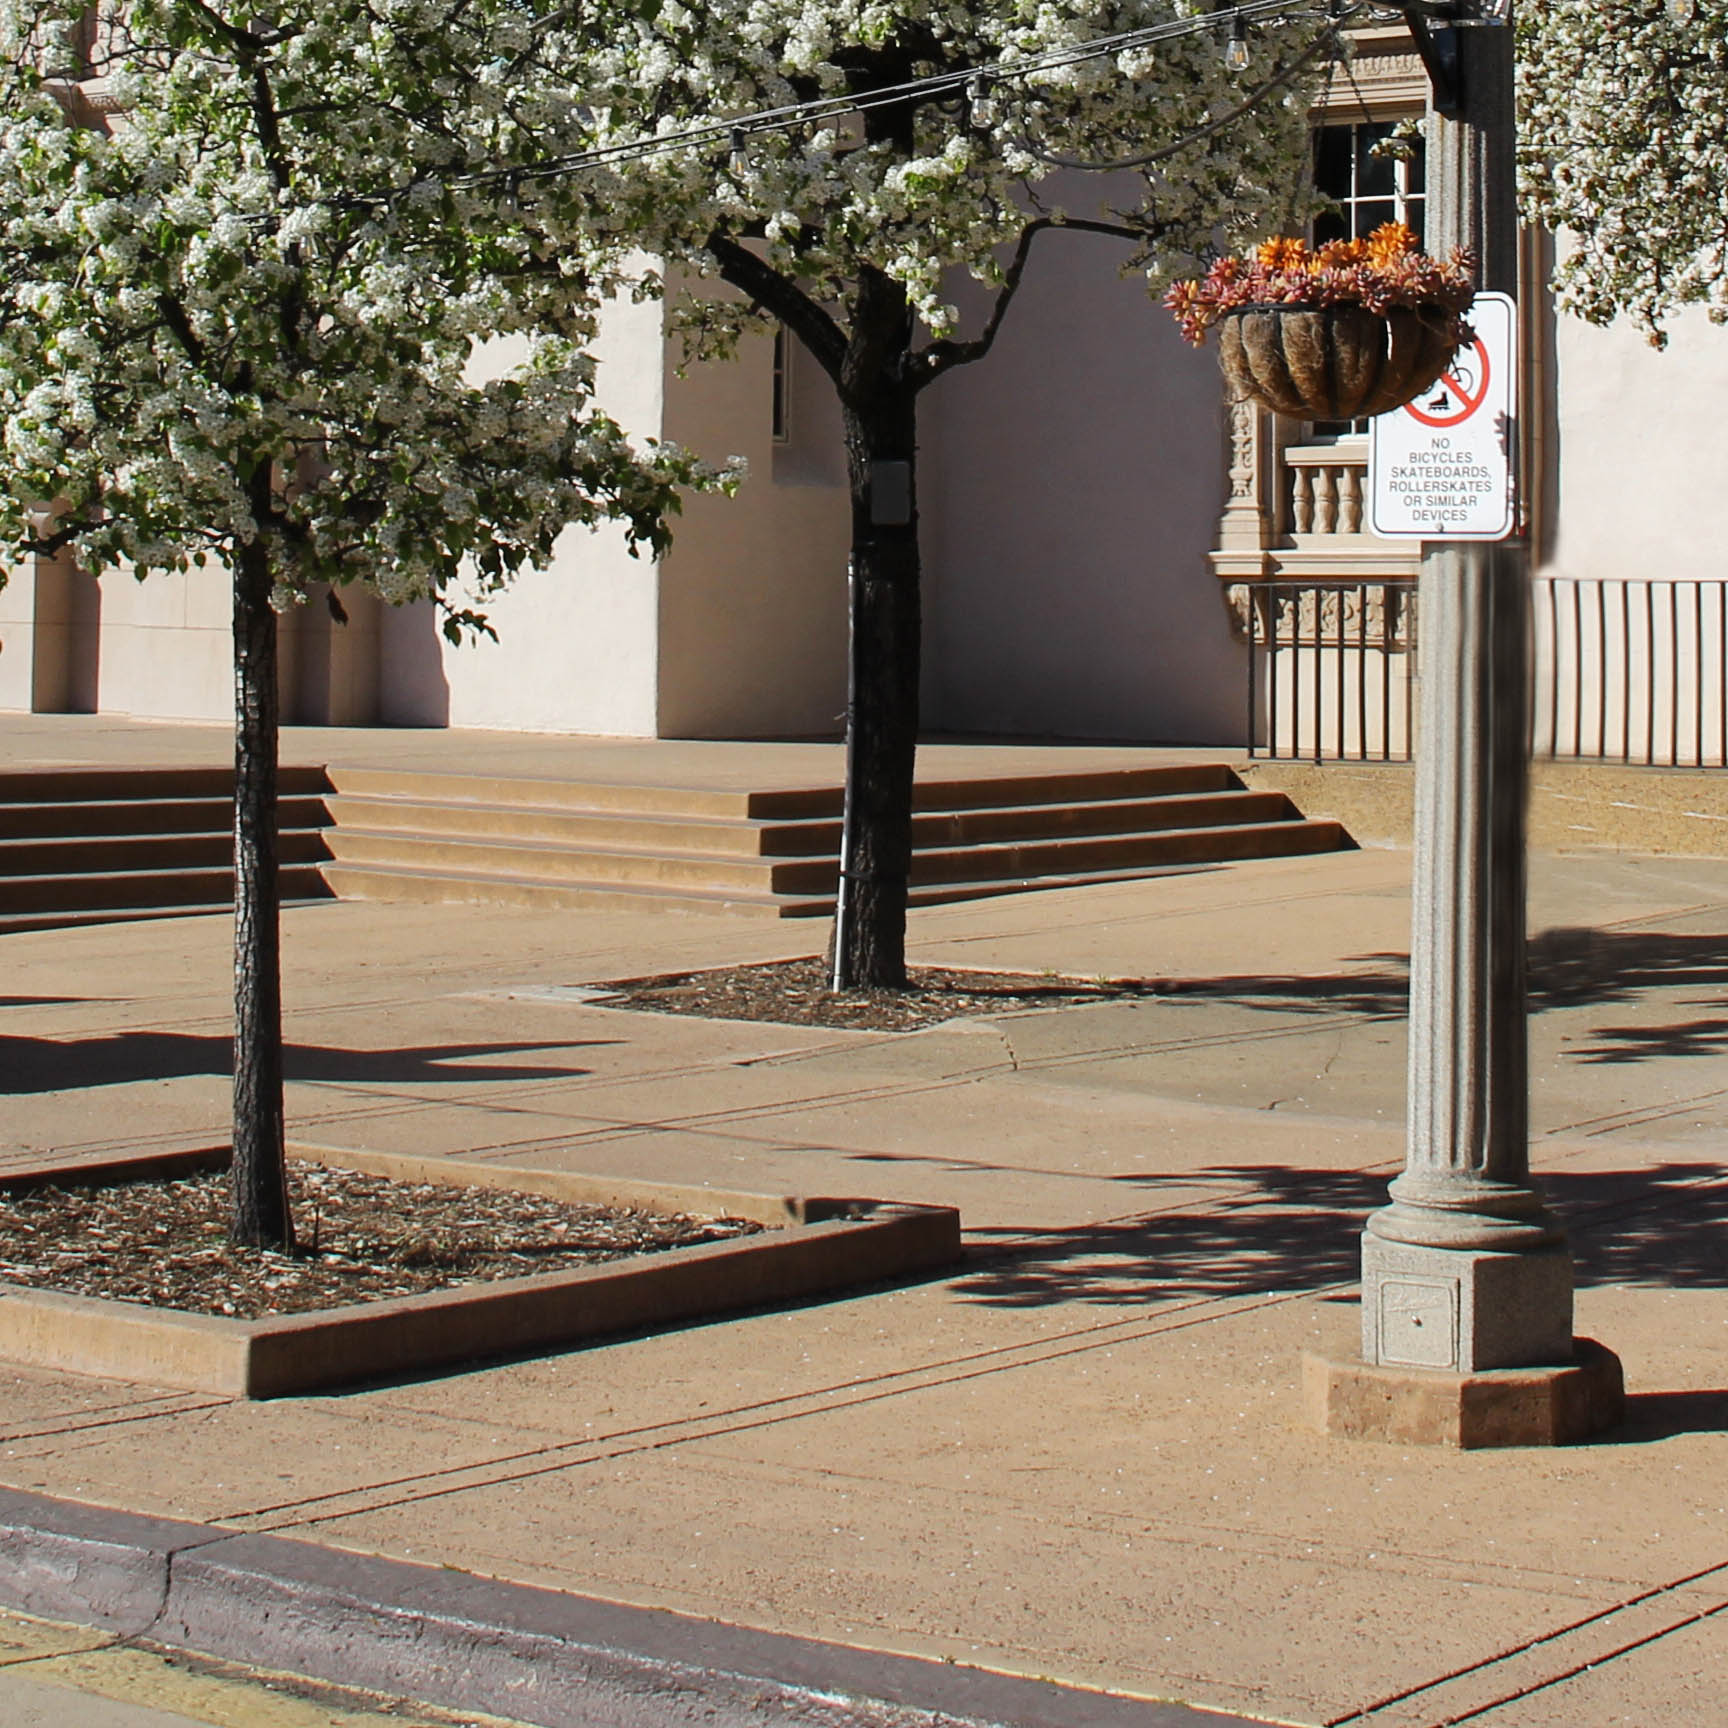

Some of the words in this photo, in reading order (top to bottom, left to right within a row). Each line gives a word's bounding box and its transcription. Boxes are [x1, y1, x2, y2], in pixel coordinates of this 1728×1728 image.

[1431, 437, 1450, 449] NO
[1409, 451, 1473, 463] BICYCLES
[1391, 466, 1492, 479] SKATEBOARDS,
[1389, 480, 1492, 492] ROLLERSKATES
[1403, 495, 1422, 507] OR
[1426, 495, 1478, 507] SIMILAR
[1412, 509, 1468, 521] DEVICES
